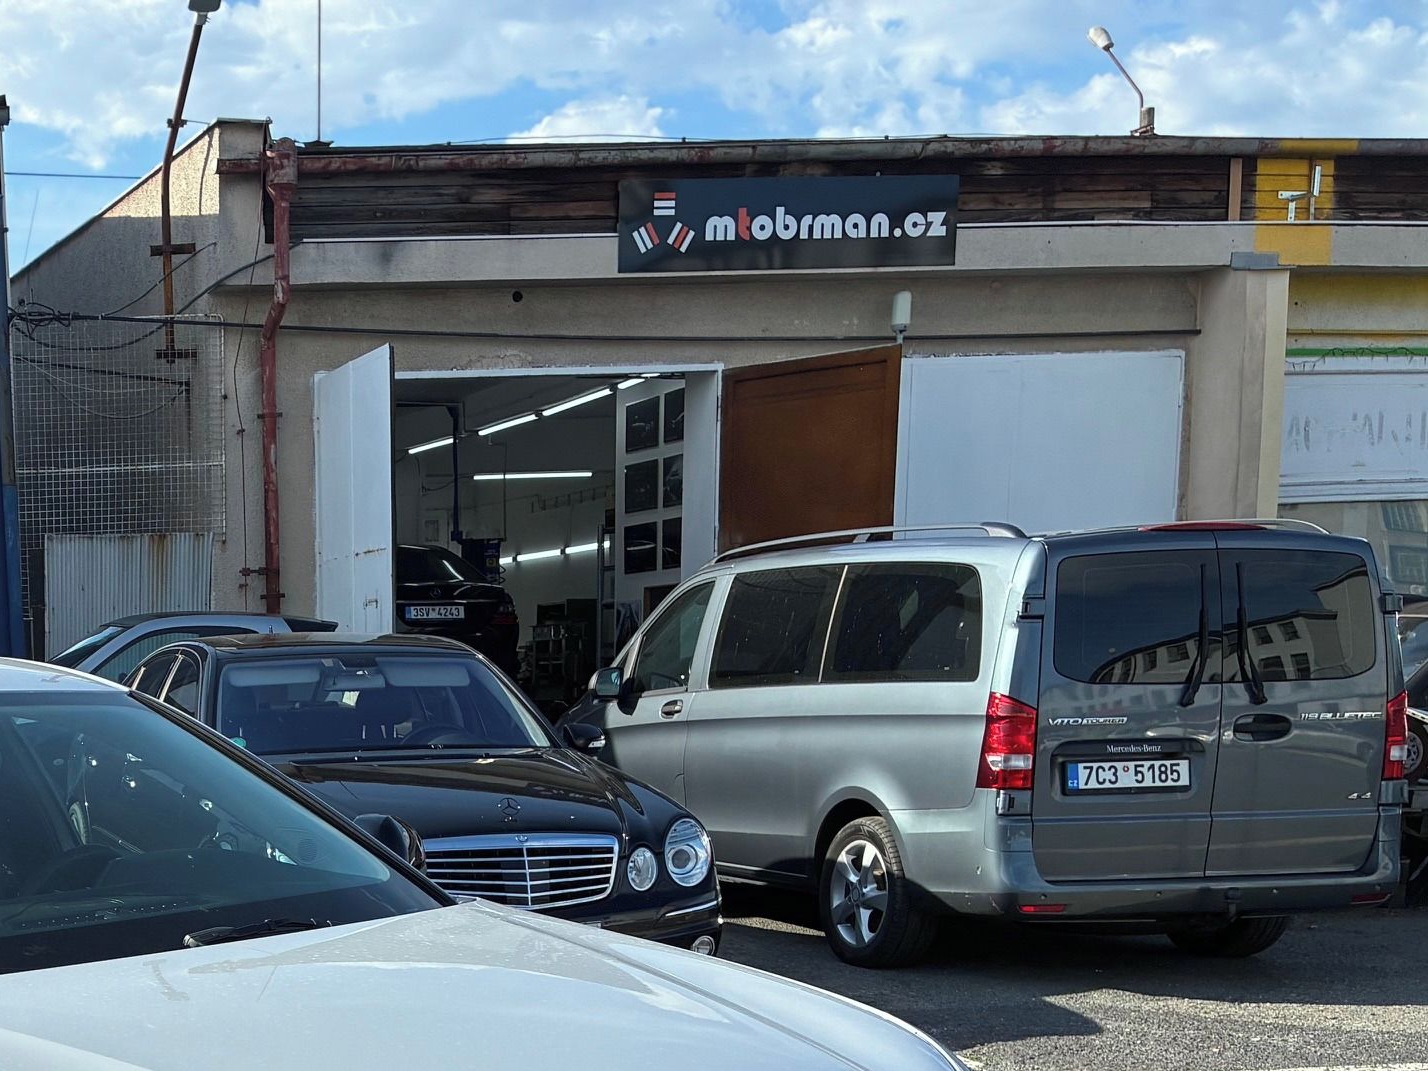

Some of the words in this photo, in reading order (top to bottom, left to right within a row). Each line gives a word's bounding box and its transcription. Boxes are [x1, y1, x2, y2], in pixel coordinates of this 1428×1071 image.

[705, 206, 947, 241] mtobrman.cz
[413, 607, 431, 617] 3SV
[437, 607, 460, 617] 4243
[1048, 717, 1082, 725] VITO
[1106, 744, 1162, 753] Mercedes-Benz
[1083, 765, 1119, 786] 7C3
[1134, 763, 1181, 784] 5185
